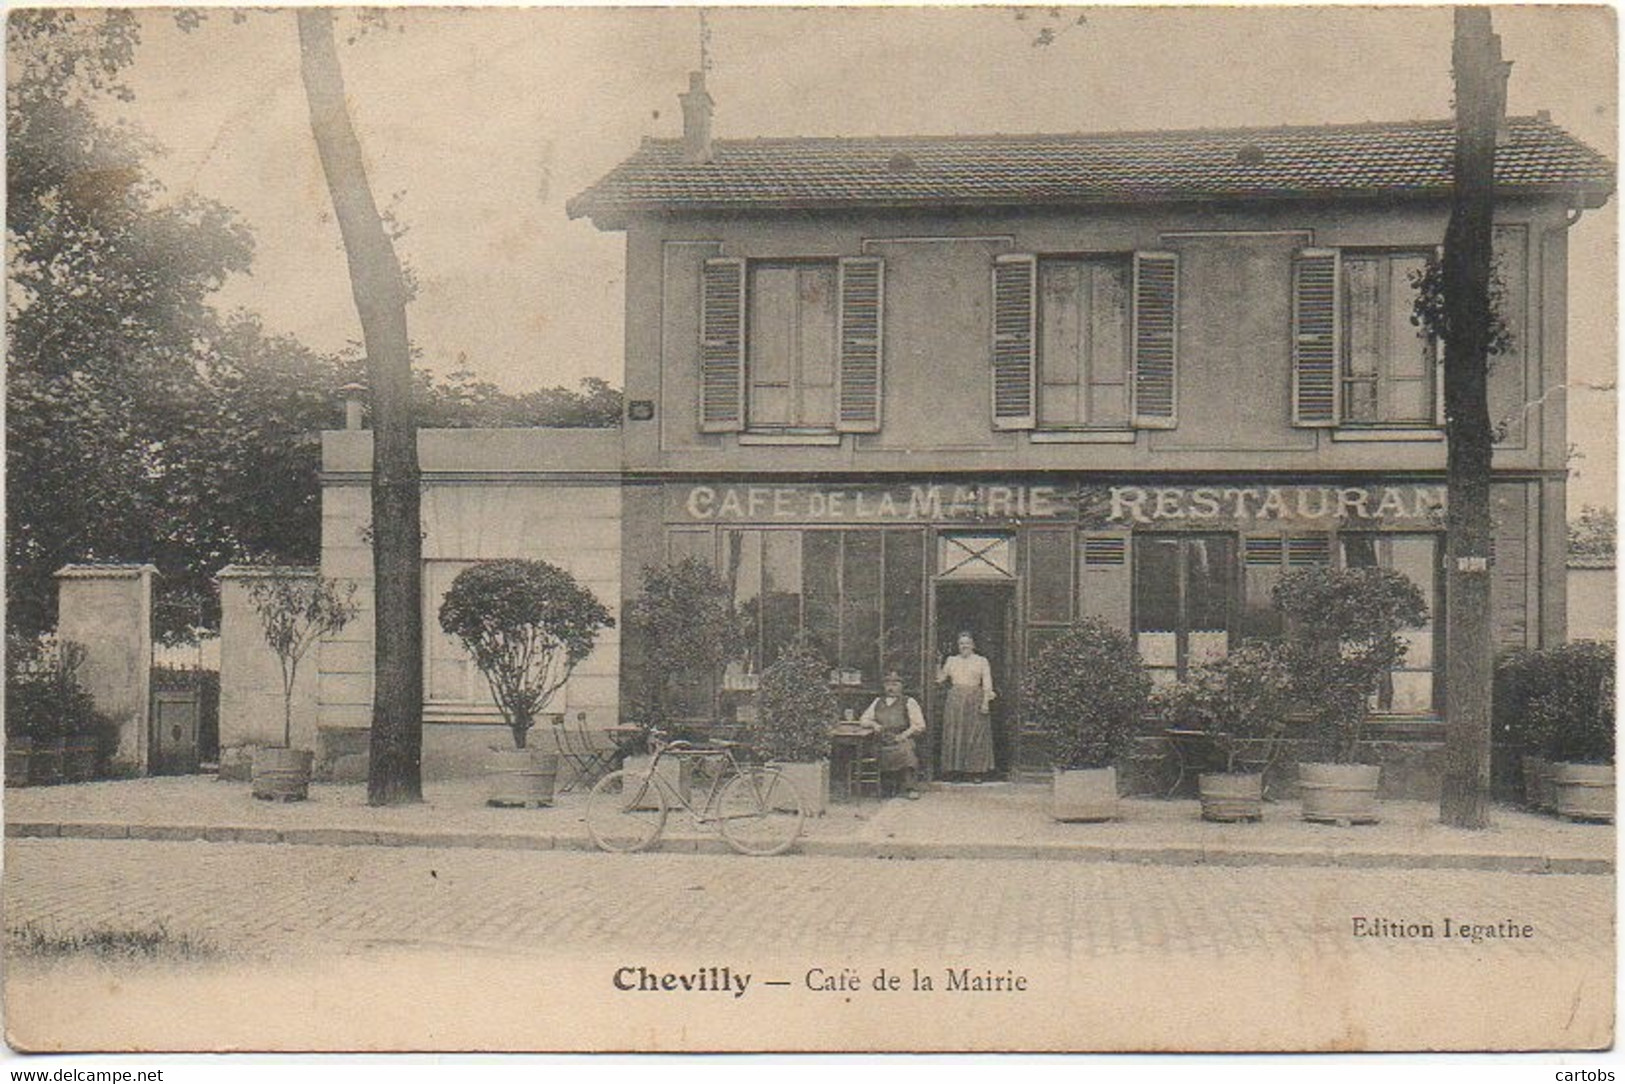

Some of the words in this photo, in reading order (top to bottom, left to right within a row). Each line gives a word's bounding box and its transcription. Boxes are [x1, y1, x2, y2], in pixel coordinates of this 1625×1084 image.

[808, 491, 844, 517] DE
[856, 490, 896, 516] LA
[1105, 485, 1449, 523] RESTAURAN
